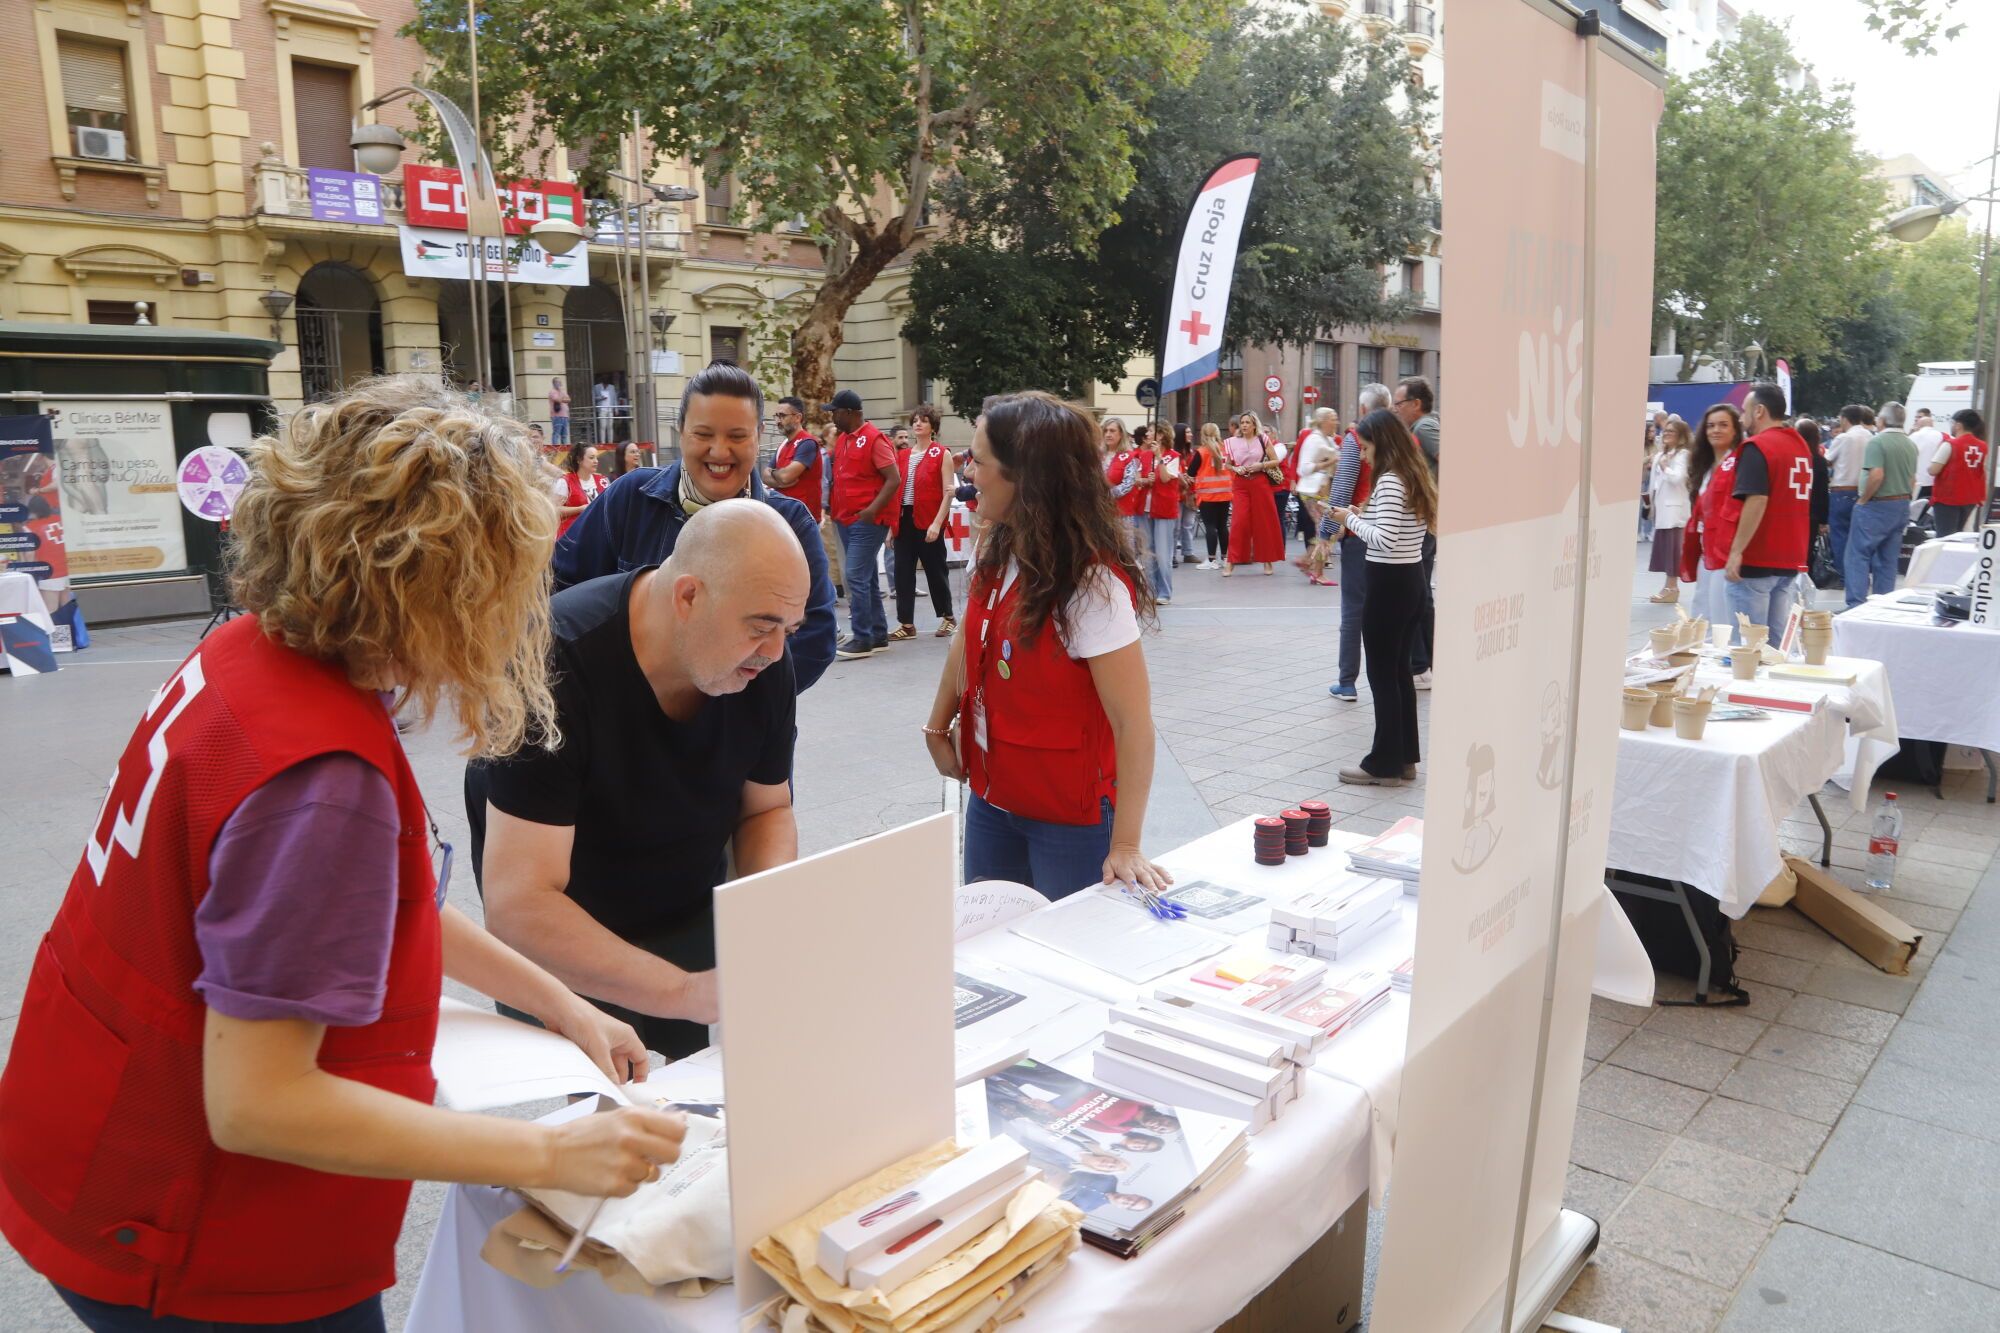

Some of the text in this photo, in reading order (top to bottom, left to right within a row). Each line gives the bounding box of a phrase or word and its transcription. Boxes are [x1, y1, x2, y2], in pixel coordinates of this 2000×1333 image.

[1191, 197, 1226, 301] Cruz Roja
[1973, 557, 1993, 625] oculus
[1049, 1092, 1109, 1131] AUTOEMPLEO
[1061, 1095, 1121, 1134] IMPULSAMOS
